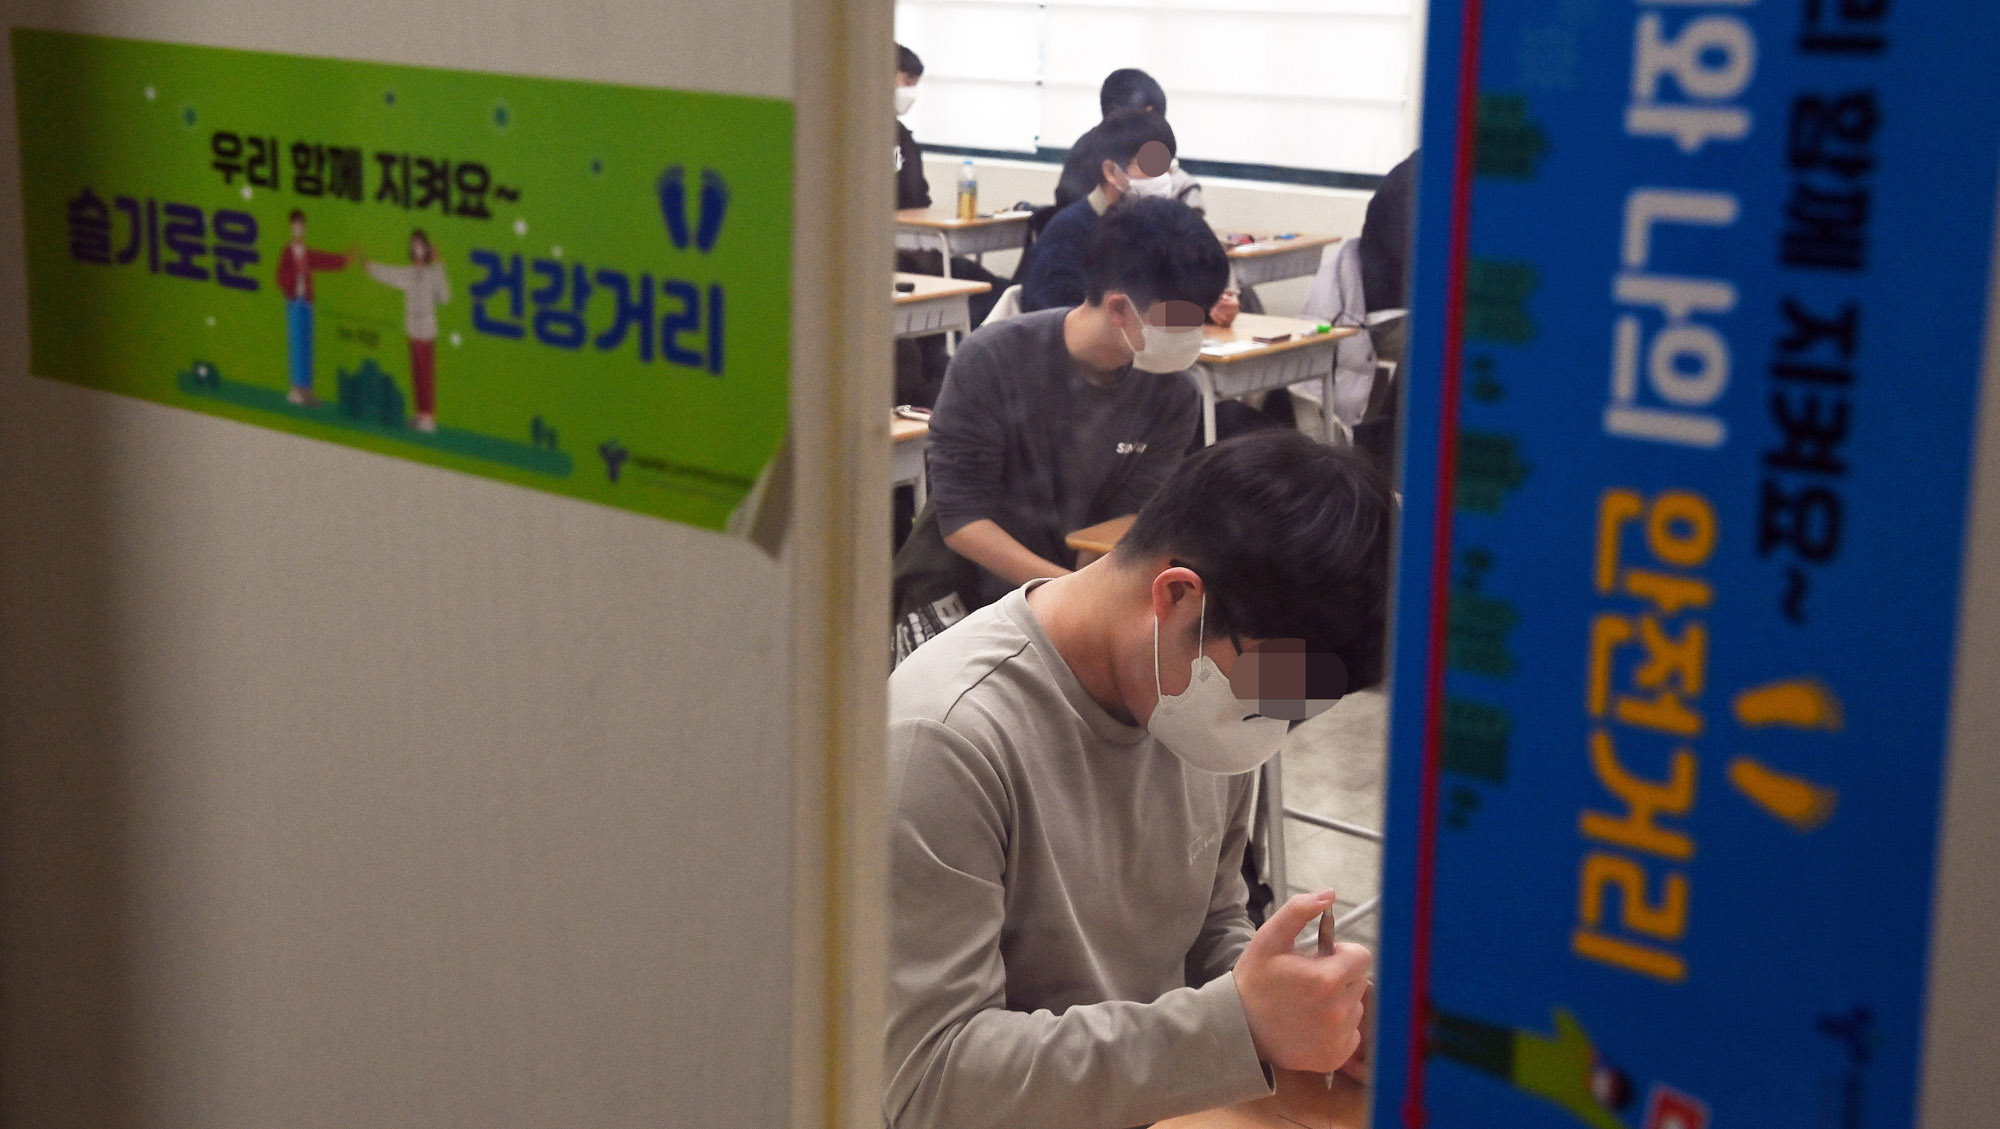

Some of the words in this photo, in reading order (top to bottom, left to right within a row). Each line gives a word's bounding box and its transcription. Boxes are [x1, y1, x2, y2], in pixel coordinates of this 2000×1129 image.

[1624, 0, 1758, 152] 와
[211, 130, 280, 190] 우리
[290, 141, 365, 203] 함께
[374, 150, 521, 220] 지켜요~
[1778, 88, 1881, 273] 함께
[67, 187, 261, 292] 슬기로운
[468, 247, 726, 376] 건강거리
[1604, 187, 1740, 449] 나의
[1571, 487, 1719, 983] 안전거리
